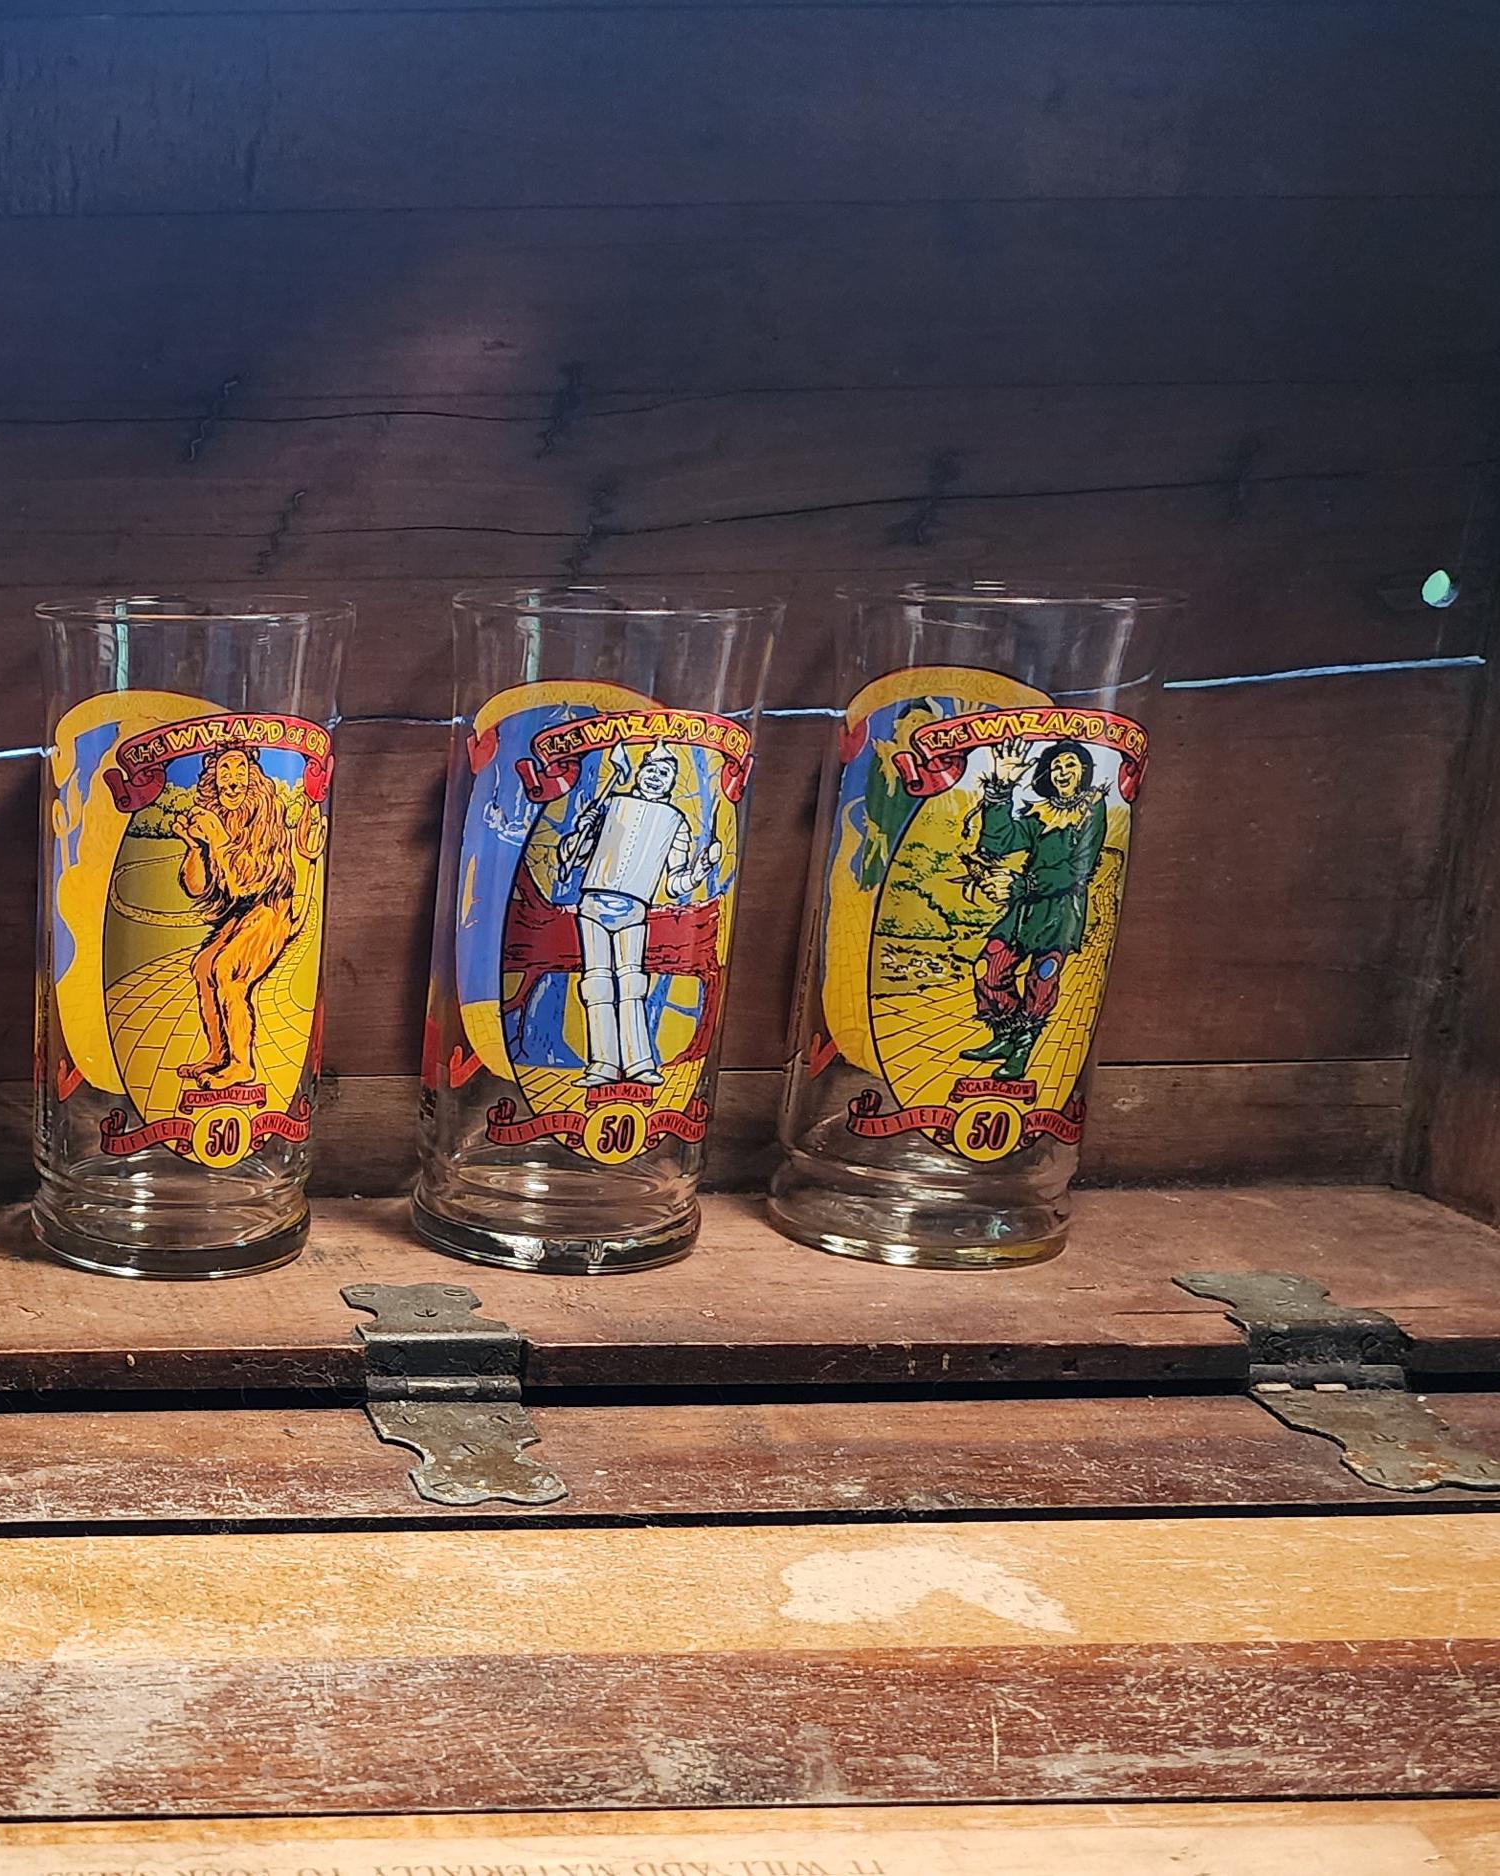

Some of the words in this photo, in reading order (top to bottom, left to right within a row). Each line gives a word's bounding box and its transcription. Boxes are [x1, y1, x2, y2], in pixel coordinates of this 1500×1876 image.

[124, 737, 165, 764] THE
[165, 718, 284, 750] WIZARD
[285, 727, 304, 745] OF
[305, 729, 328, 756] OZ
[538, 731, 583, 755] THE
[583, 714, 705, 745] WIZARD
[705, 724, 725, 744] OF
[724, 729, 748, 758] OZ
[920, 726, 968, 750] THE
[971, 711, 1105, 740] WIZARD
[1105, 724, 1125, 741] OF
[1125, 728, 1146, 754] OZ
[187, 1088, 240, 1104] COWARDLY
[241, 1087, 265, 1100] LION
[598, 1085, 617, 1097] TIN
[621, 1085, 648, 1098] MAN
[958, 1080, 1031, 1095] SCARECROW
[110, 1120, 190, 1150] FIFTIETH
[205, 1118, 239, 1157] 50
[497, 1115, 582, 1142] FIFTIETH
[598, 1114, 636, 1153] 50
[858, 1110, 950, 1134] FIFTIETH
[967, 1111, 1011, 1150] 50
[633, 1862, 709, 1876] ADD
[729, 1860, 831, 1876] WILL
[848, 1860, 885, 1876] IT
